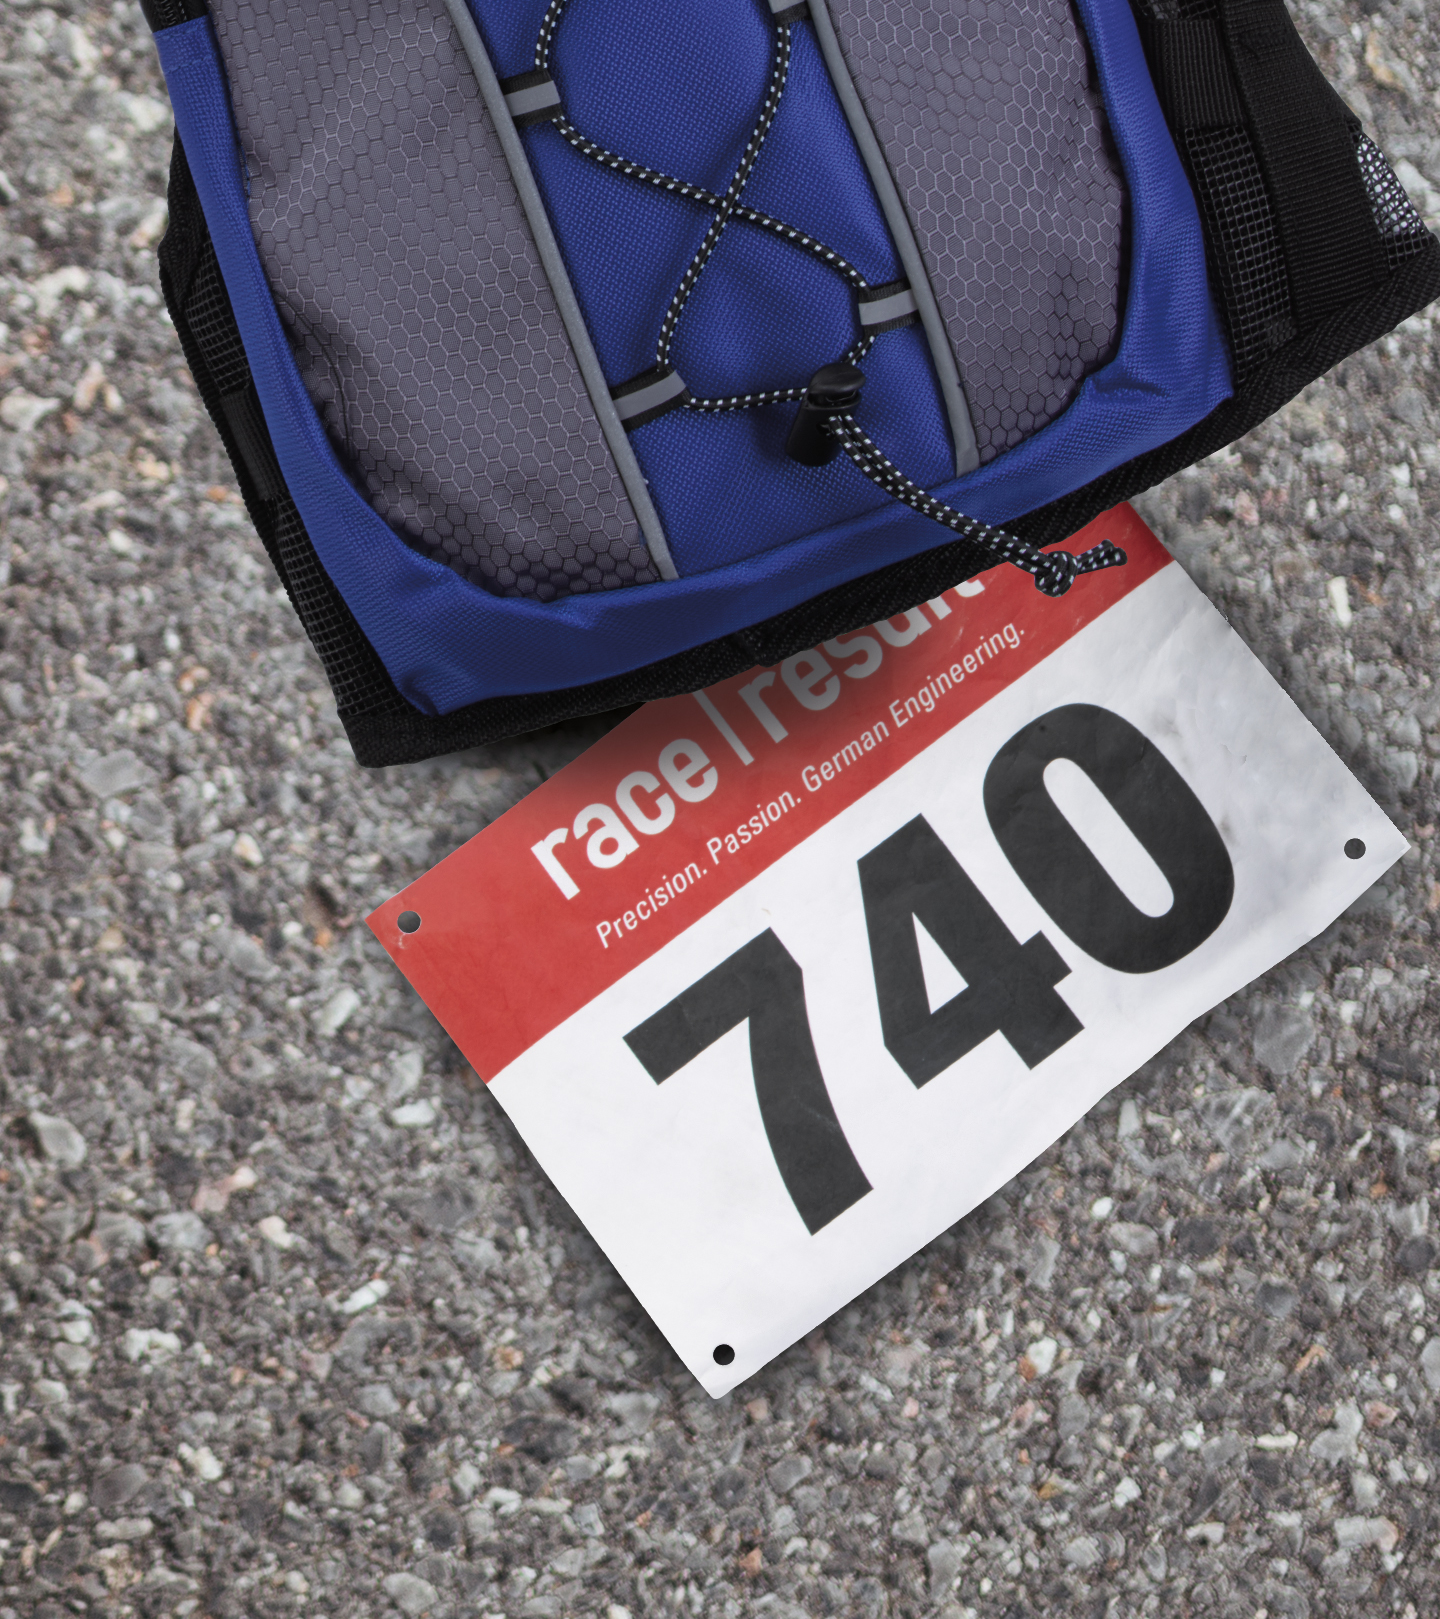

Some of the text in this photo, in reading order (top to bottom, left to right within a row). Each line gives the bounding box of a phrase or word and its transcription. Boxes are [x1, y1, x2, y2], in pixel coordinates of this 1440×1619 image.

[530, 737, 719, 901] race
[595, 622, 1026, 950] Precision. Passion. German Engineering.
[622, 703, 1235, 1236] 740
